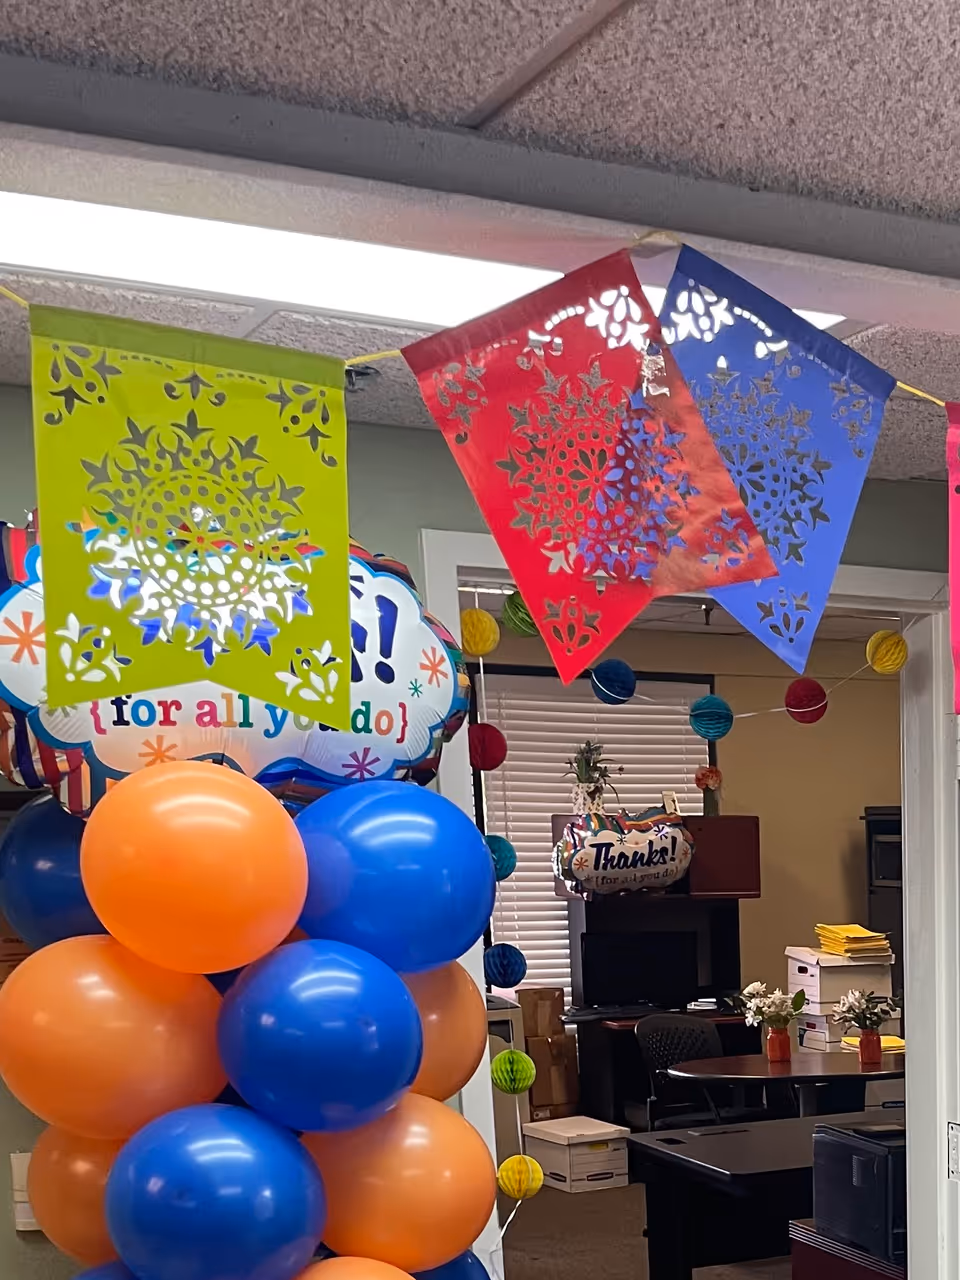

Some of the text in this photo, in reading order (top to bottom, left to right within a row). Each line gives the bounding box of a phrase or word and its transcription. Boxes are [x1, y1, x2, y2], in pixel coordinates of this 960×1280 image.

[195, 692, 254, 729] all
[263, 703, 340, 738] yo
[589, 836, 678, 871] Thanks!
[640, 872, 660, 882] you
